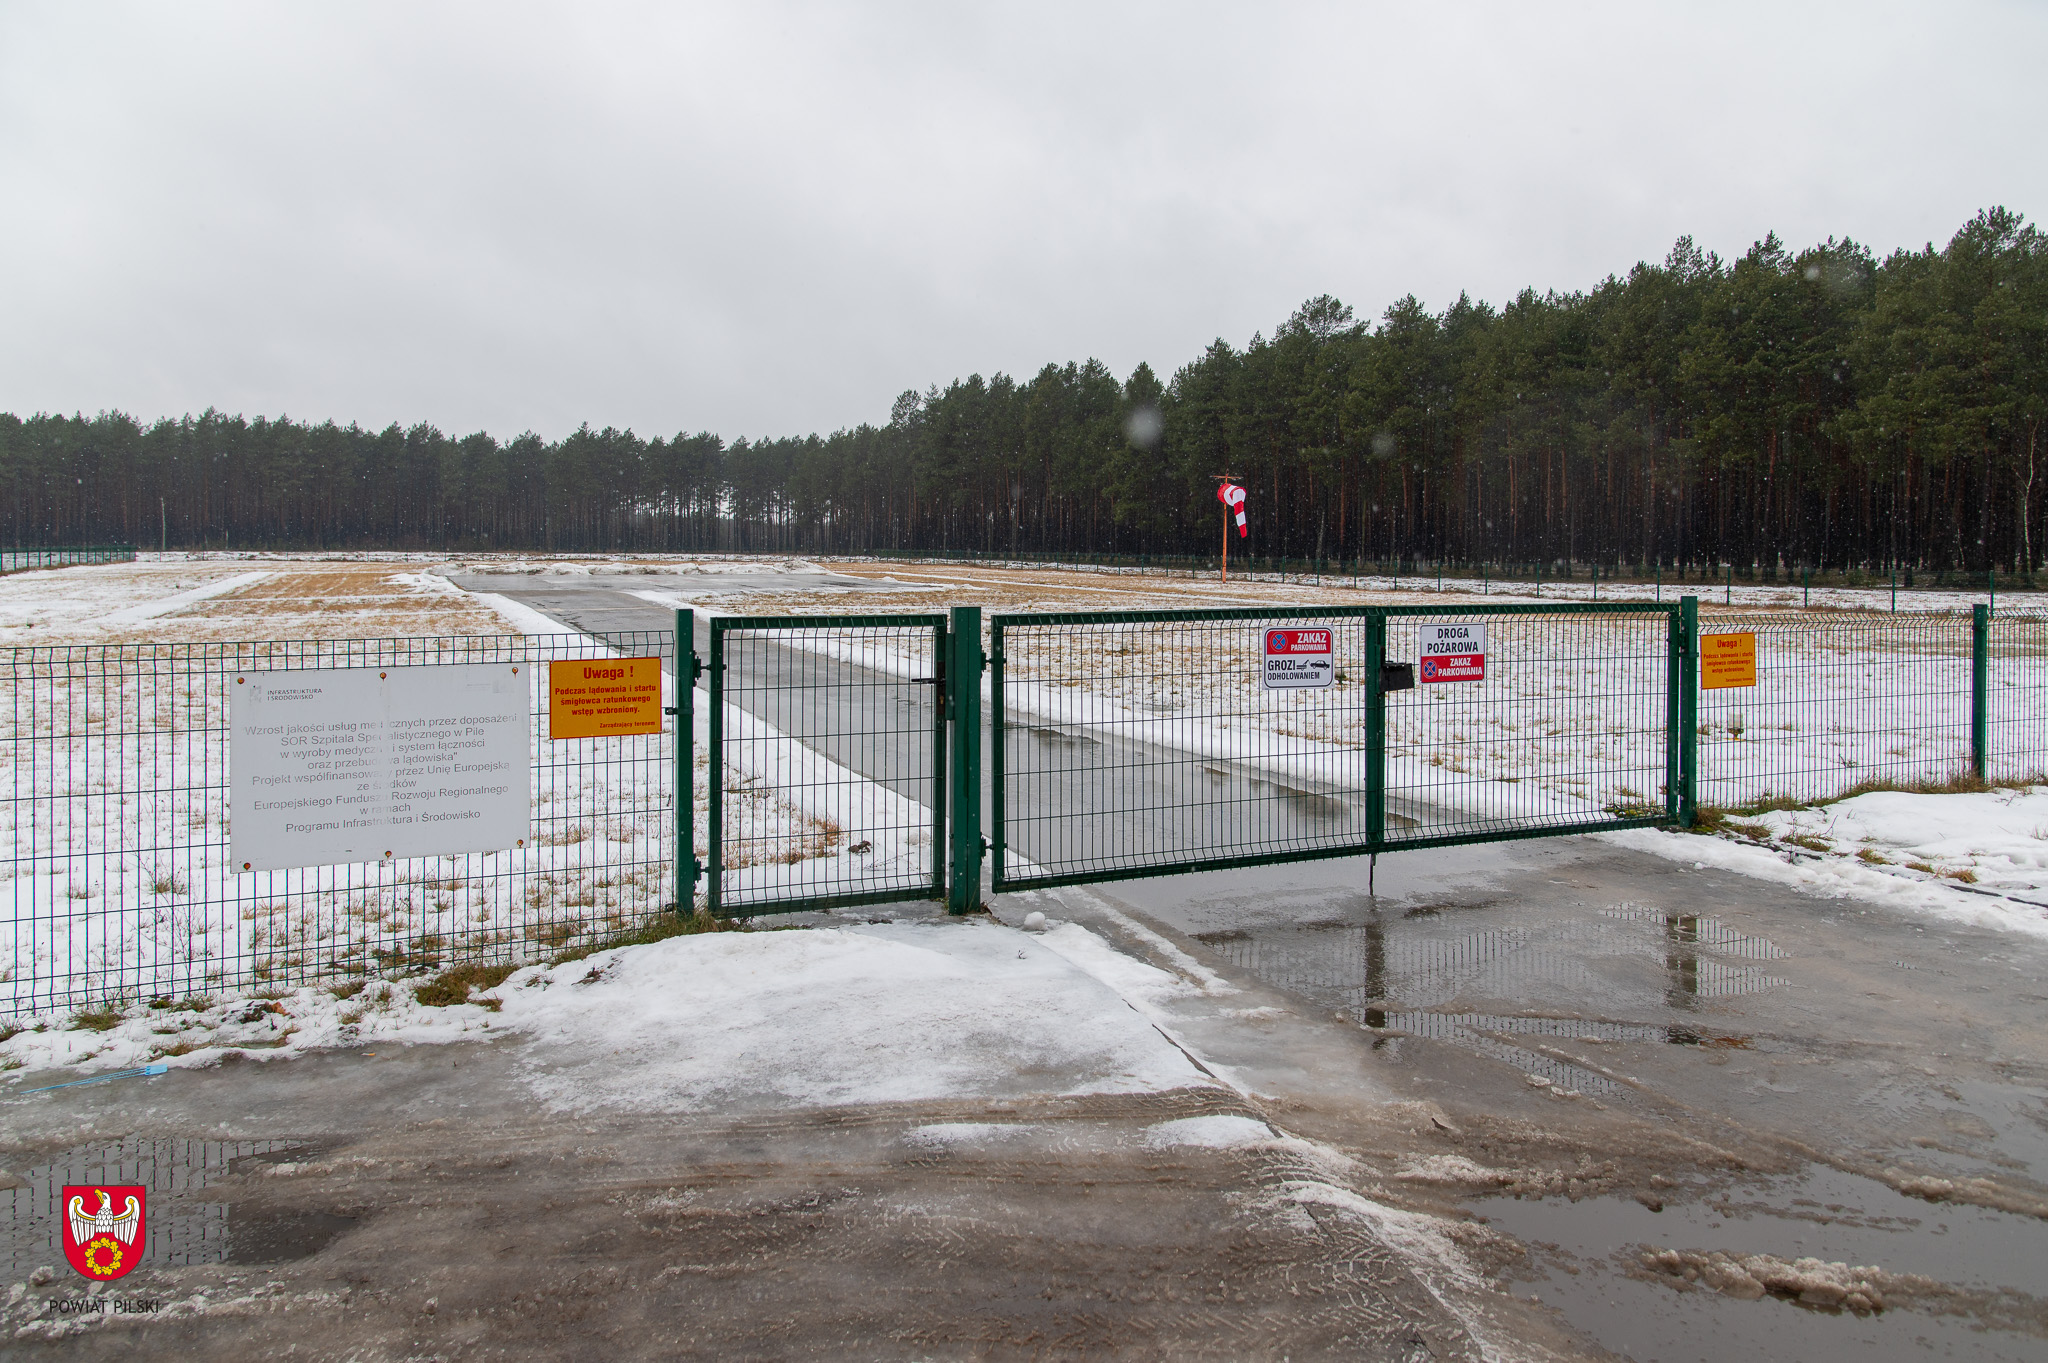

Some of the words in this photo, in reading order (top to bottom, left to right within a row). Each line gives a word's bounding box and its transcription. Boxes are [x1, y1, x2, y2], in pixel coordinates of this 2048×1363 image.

[1297, 632, 1327, 644] ZAKAZ
[1438, 628, 1469, 639] DROGA
[1427, 640, 1479, 653] POŻAROWA
[1717, 639, 1737, 649] Uwaga
[1268, 660, 1295, 671] GROZI
[1450, 657, 1471, 666] ZAKAZ
[583, 667, 624, 680] Uwaga
[630, 666, 634, 677] !
[1268, 672, 1320, 680] ODHOLOWANIEM
[1438, 667, 1483, 677] PARKOWANIA
[555, 687, 586, 695] Podczas
[589, 685, 627, 695] lądowania
[560, 697, 601, 706] śmigłowca
[603, 695, 651, 704] ratunkowego
[572, 708, 594, 716] wstęp
[597, 706, 640, 714] wzbroniony.
[245, 725, 284, 735] Wzrost
[287, 723, 325, 735] jakości
[328, 722, 357, 732] usług
[428, 718, 457, 728] przez
[281, 736, 308, 746] SOR
[311, 734, 354, 746] Szpitala
[465, 727, 485, 736] Pile
[280, 751, 289, 759] w
[292, 748, 332, 760] wyroby
[398, 743, 435, 754] system
[438, 739, 485, 751] łączności
[307, 761, 332, 770] oraz
[403, 752, 458, 765] lądowiska"
[252, 775, 291, 787] Projekt
[395, 767, 424, 778] przez
[427, 765, 451, 775] Unię
[454, 761, 510, 773] Europejską
[357, 783, 370, 791] ze
[254, 797, 333, 810] Europejskiego
[392, 790, 436, 800] Rozwoju
[439, 785, 508, 798] Regionalnego
[360, 807, 368, 815] w
[286, 821, 340, 833] Programu
[343, 815, 413, 828] Infrastruktura
[415, 814, 419, 823] i
[421, 810, 481, 823] Środowisko
